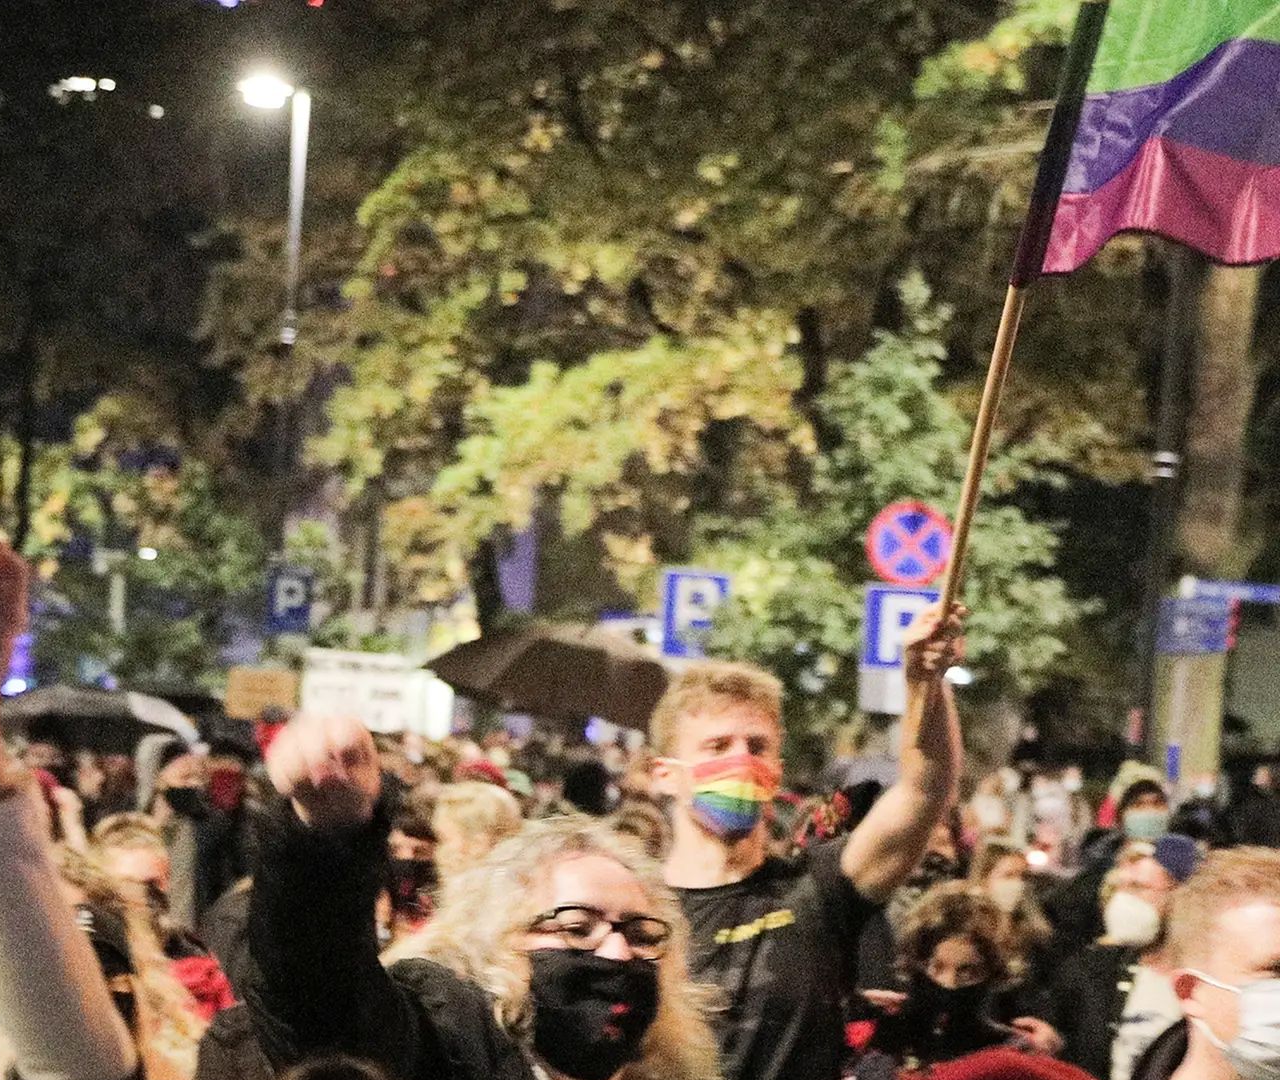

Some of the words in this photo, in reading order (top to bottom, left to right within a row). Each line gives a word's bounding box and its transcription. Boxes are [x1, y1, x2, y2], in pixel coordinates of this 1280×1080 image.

[275, 577, 306, 617] P
[676, 577, 719, 641] P
[879, 594, 928, 661] P
